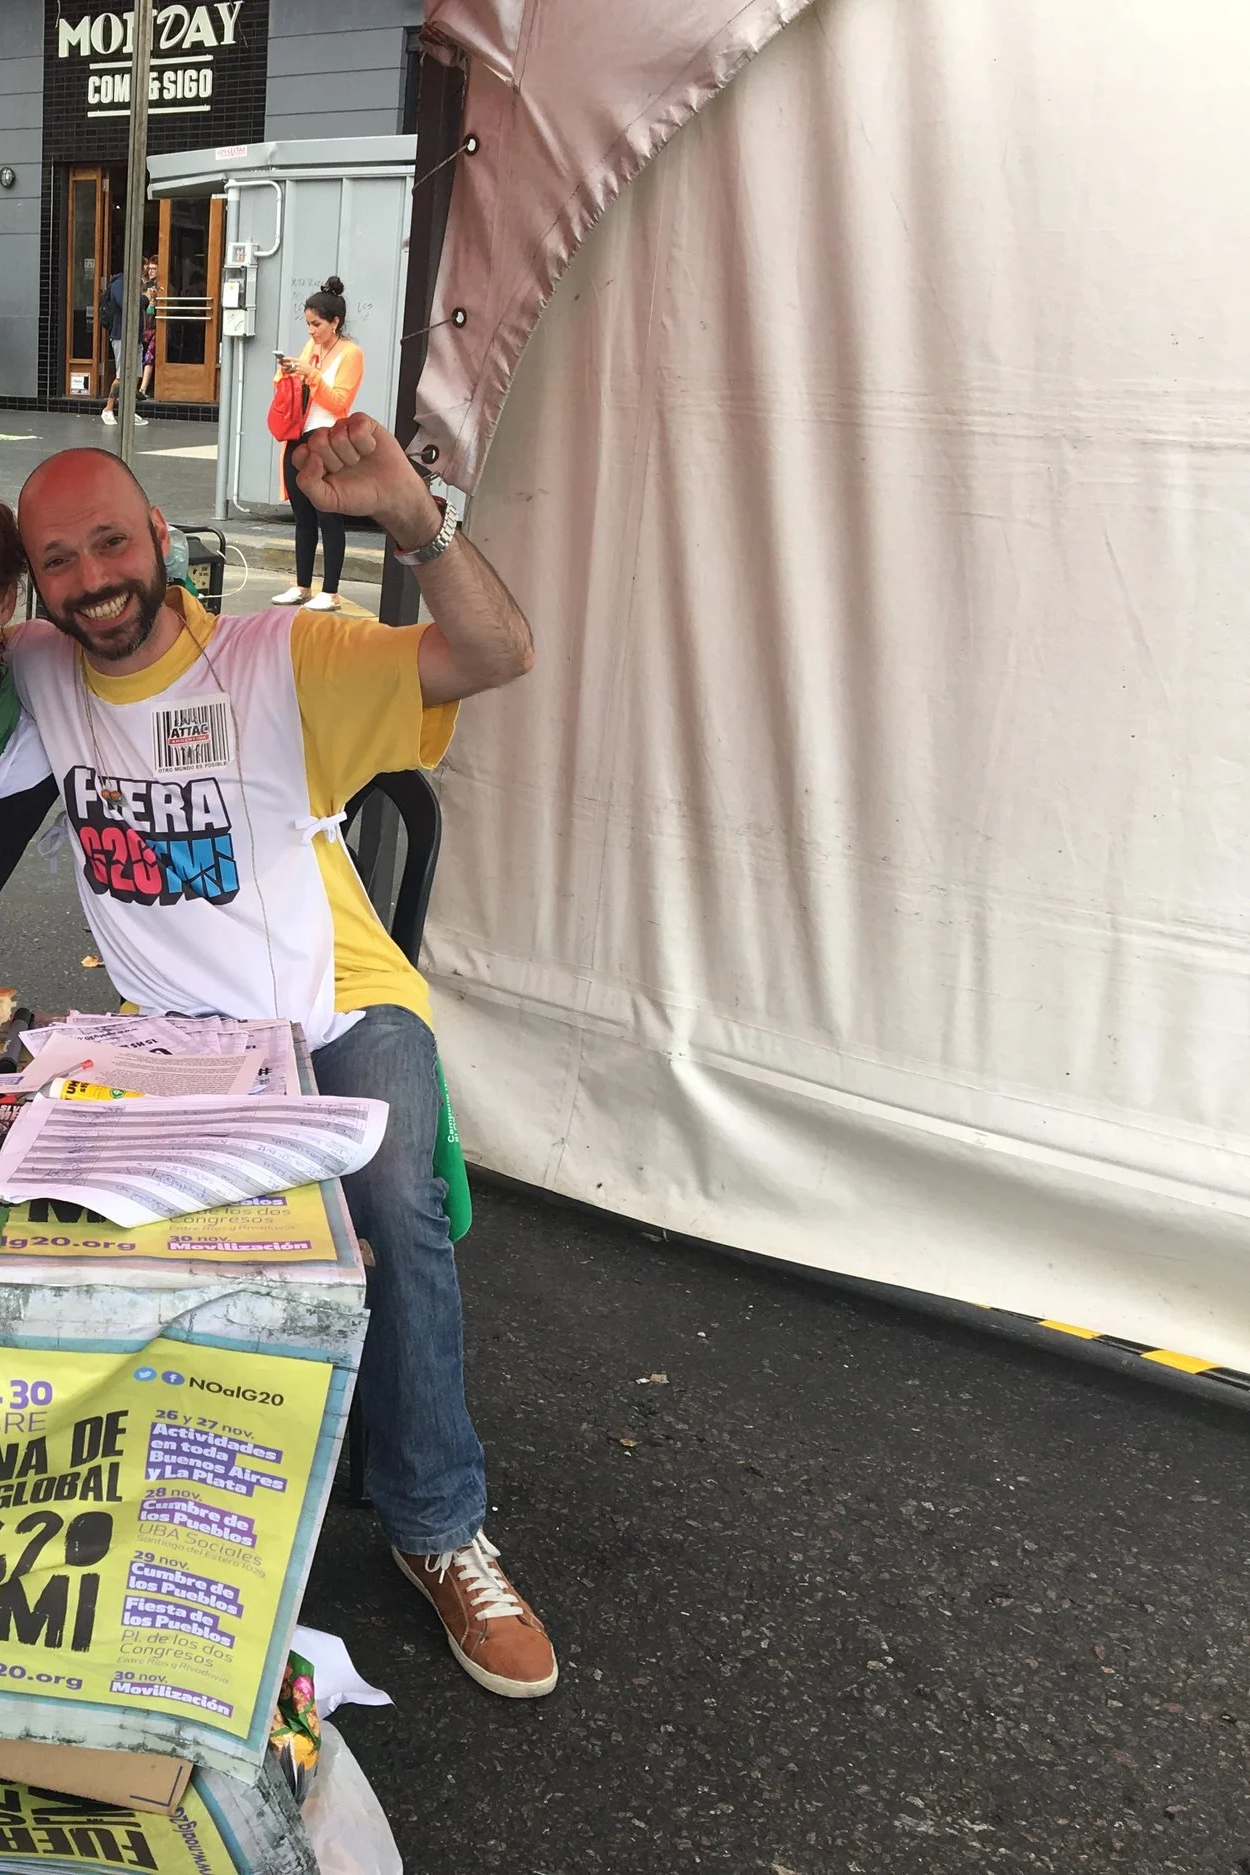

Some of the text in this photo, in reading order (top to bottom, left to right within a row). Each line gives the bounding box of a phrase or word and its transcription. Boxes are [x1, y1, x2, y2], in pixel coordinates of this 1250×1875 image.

[58, 1, 244, 58] MONDAY
[163, 68, 214, 99] SIGO
[170, 722, 209, 739] ATTAC
[174, 764, 194, 773] MUNDO
[195, 762, 204, 771] ES
[204, 760, 229, 770] POSIBLE
[168, 1213, 274, 1228] Congresos
[224, 1206, 291, 1218] los dos
[169, 1234, 231, 1243] 30 nov.
[170, 1241, 309, 1252] Movilización
[9, 1379, 54, 1410] 30
[188, 1376, 285, 1407] NOalG20
[70, 1409, 130, 1469] DE
[155, 1409, 256, 1440] 26 y 27 nov.
[150, 1439, 229, 1462] en toda
[152, 1423, 278, 1461] Actividades
[147, 1465, 248, 1494] y La Plata
[148, 1449, 284, 1490] Buenos Aires
[144, 1487, 202, 1502] 28 nov.
[140, 1511, 253, 1547] los Pueblos
[142, 1500, 249, 1531] Cumbre de
[133, 1550, 191, 1571] 29 nov.
[138, 1523, 263, 1567] UBA Sociales
[128, 1575, 239, 1615] los Pueblos
[130, 1561, 236, 1600] Cumbre de
[125, 1596, 215, 1627] Fiesta de
[122, 1611, 232, 1647] los Pueblos
[119, 1642, 214, 1668] Congresos
[121, 1629, 235, 1664] Pl. de los dos
[114, 1670, 169, 1684] 30 nov.
[111, 1681, 231, 1717] Movilización
